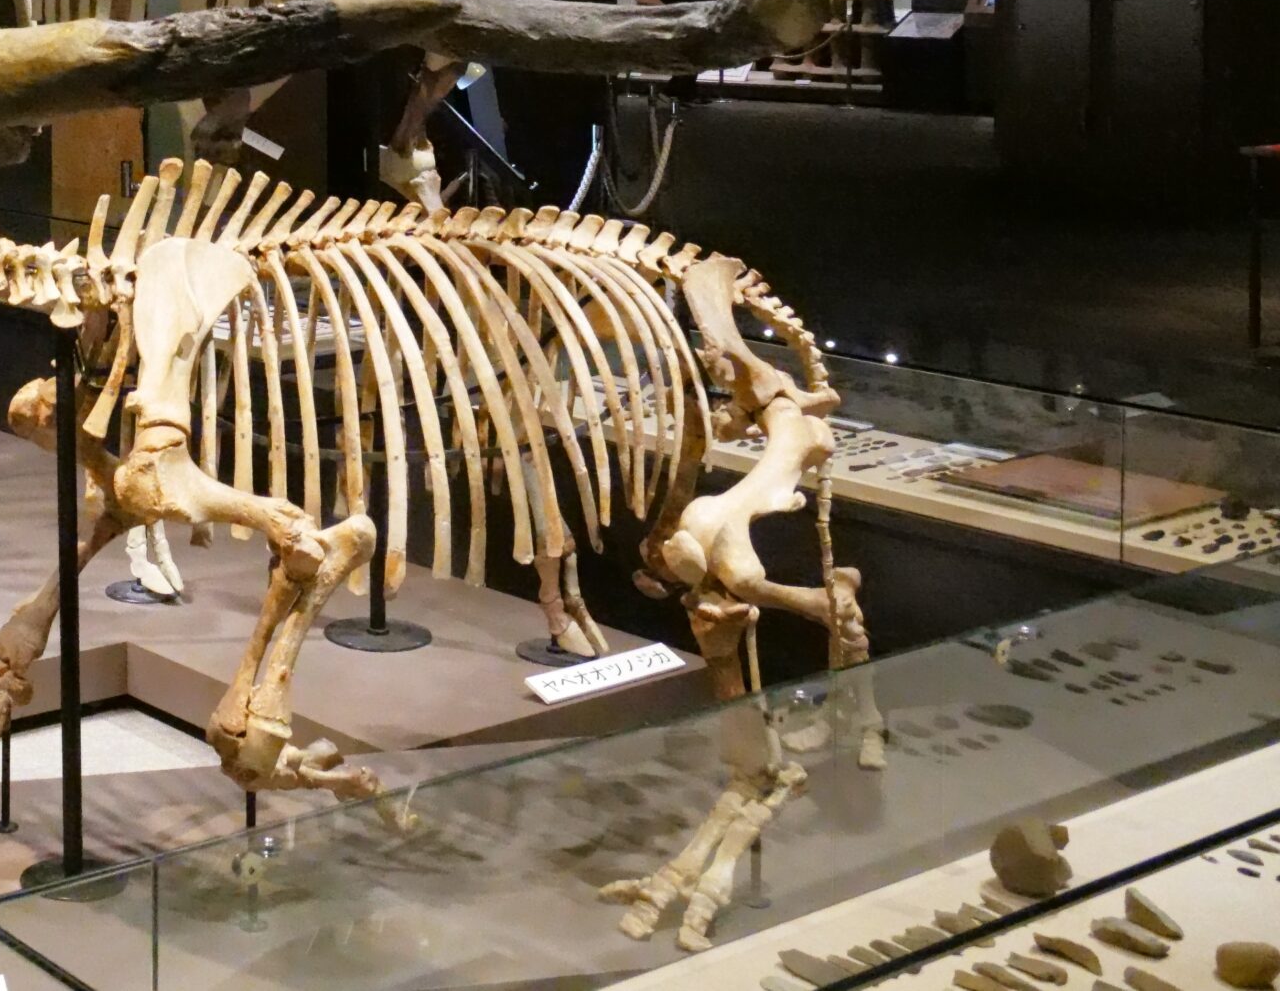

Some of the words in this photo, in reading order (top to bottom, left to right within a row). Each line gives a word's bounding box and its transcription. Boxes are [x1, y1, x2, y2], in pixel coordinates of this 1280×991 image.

[543, 651, 671, 692] ヤベオオツノジカ
